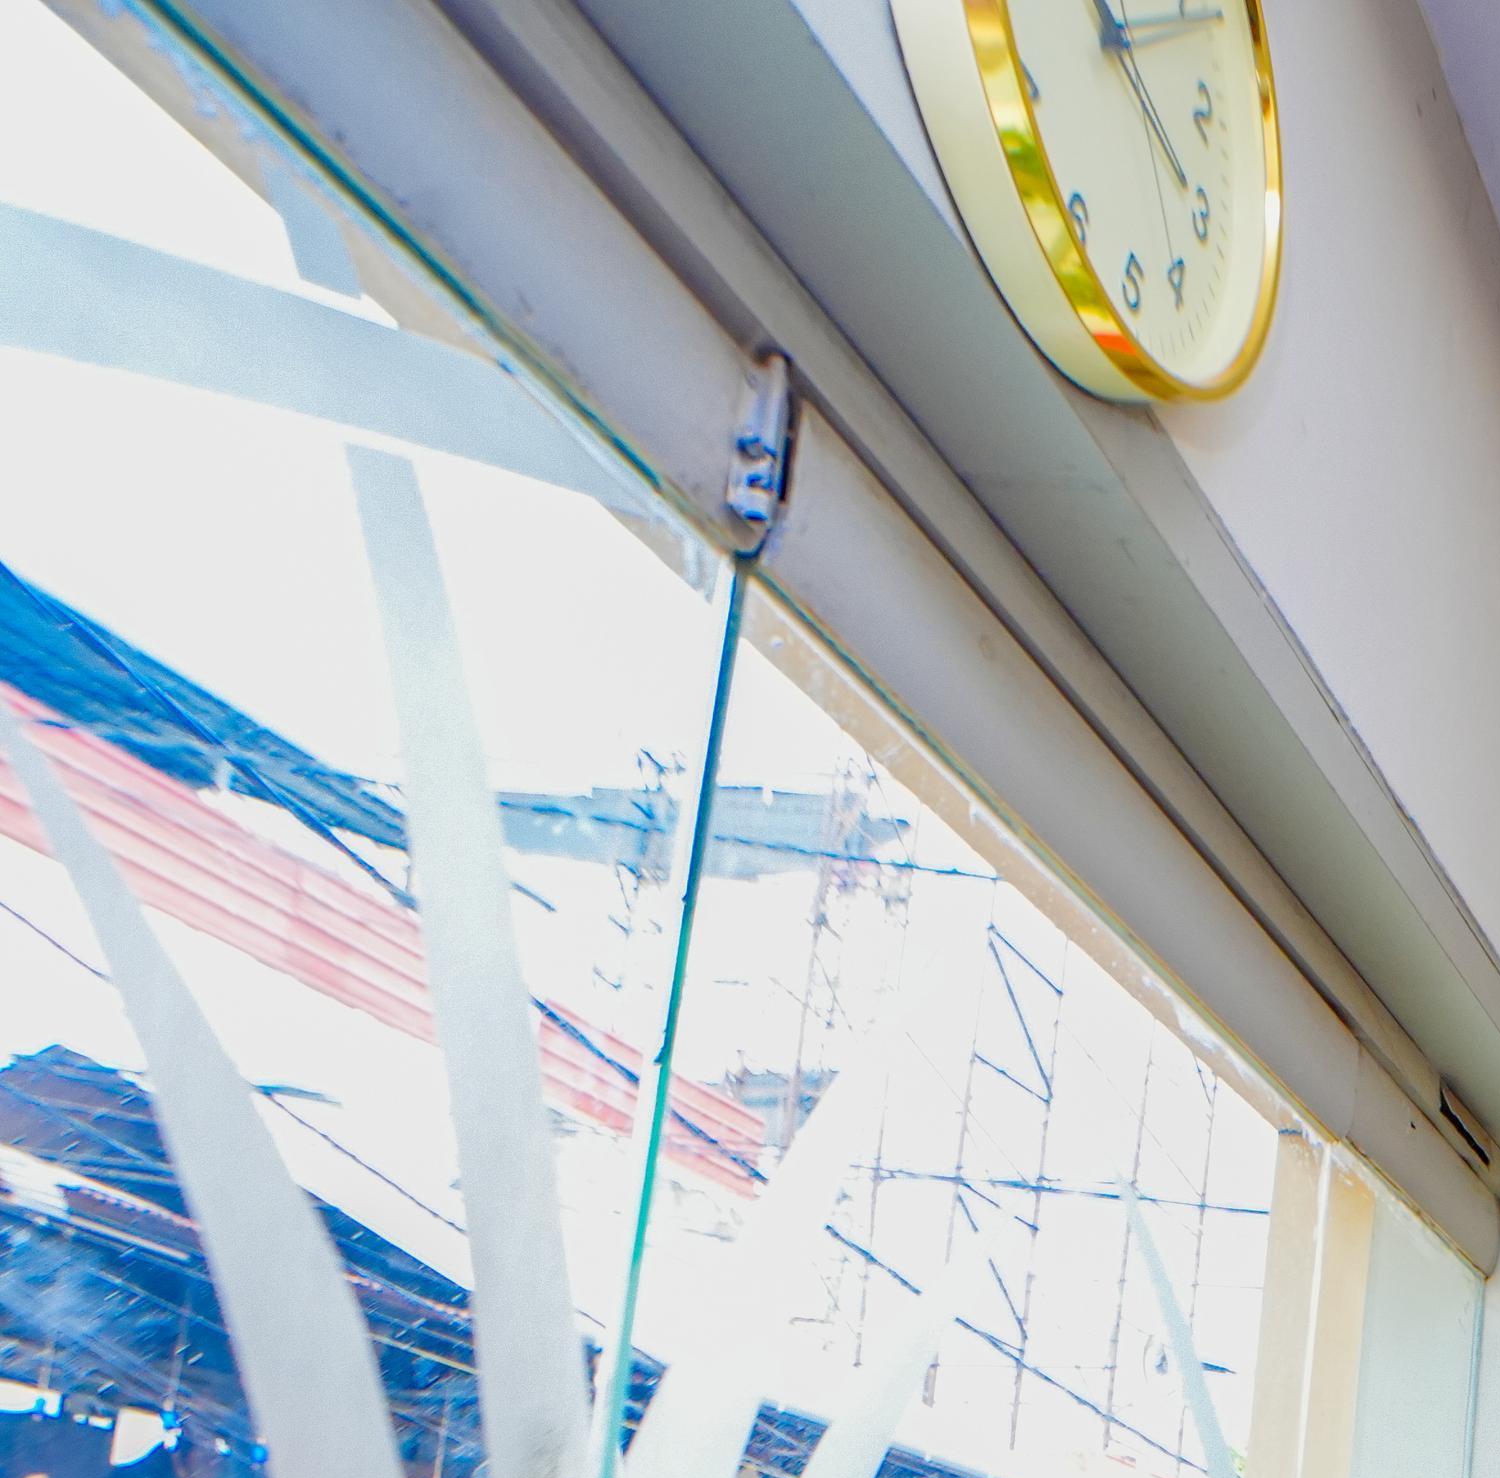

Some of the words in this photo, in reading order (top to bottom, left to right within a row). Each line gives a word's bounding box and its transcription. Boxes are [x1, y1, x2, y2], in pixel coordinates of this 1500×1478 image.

[1192, 80, 1212, 149] 2
[1192, 185, 1210, 242] 3
[1122, 251, 1145, 310] 5
[1168, 257, 1185, 311] 4
